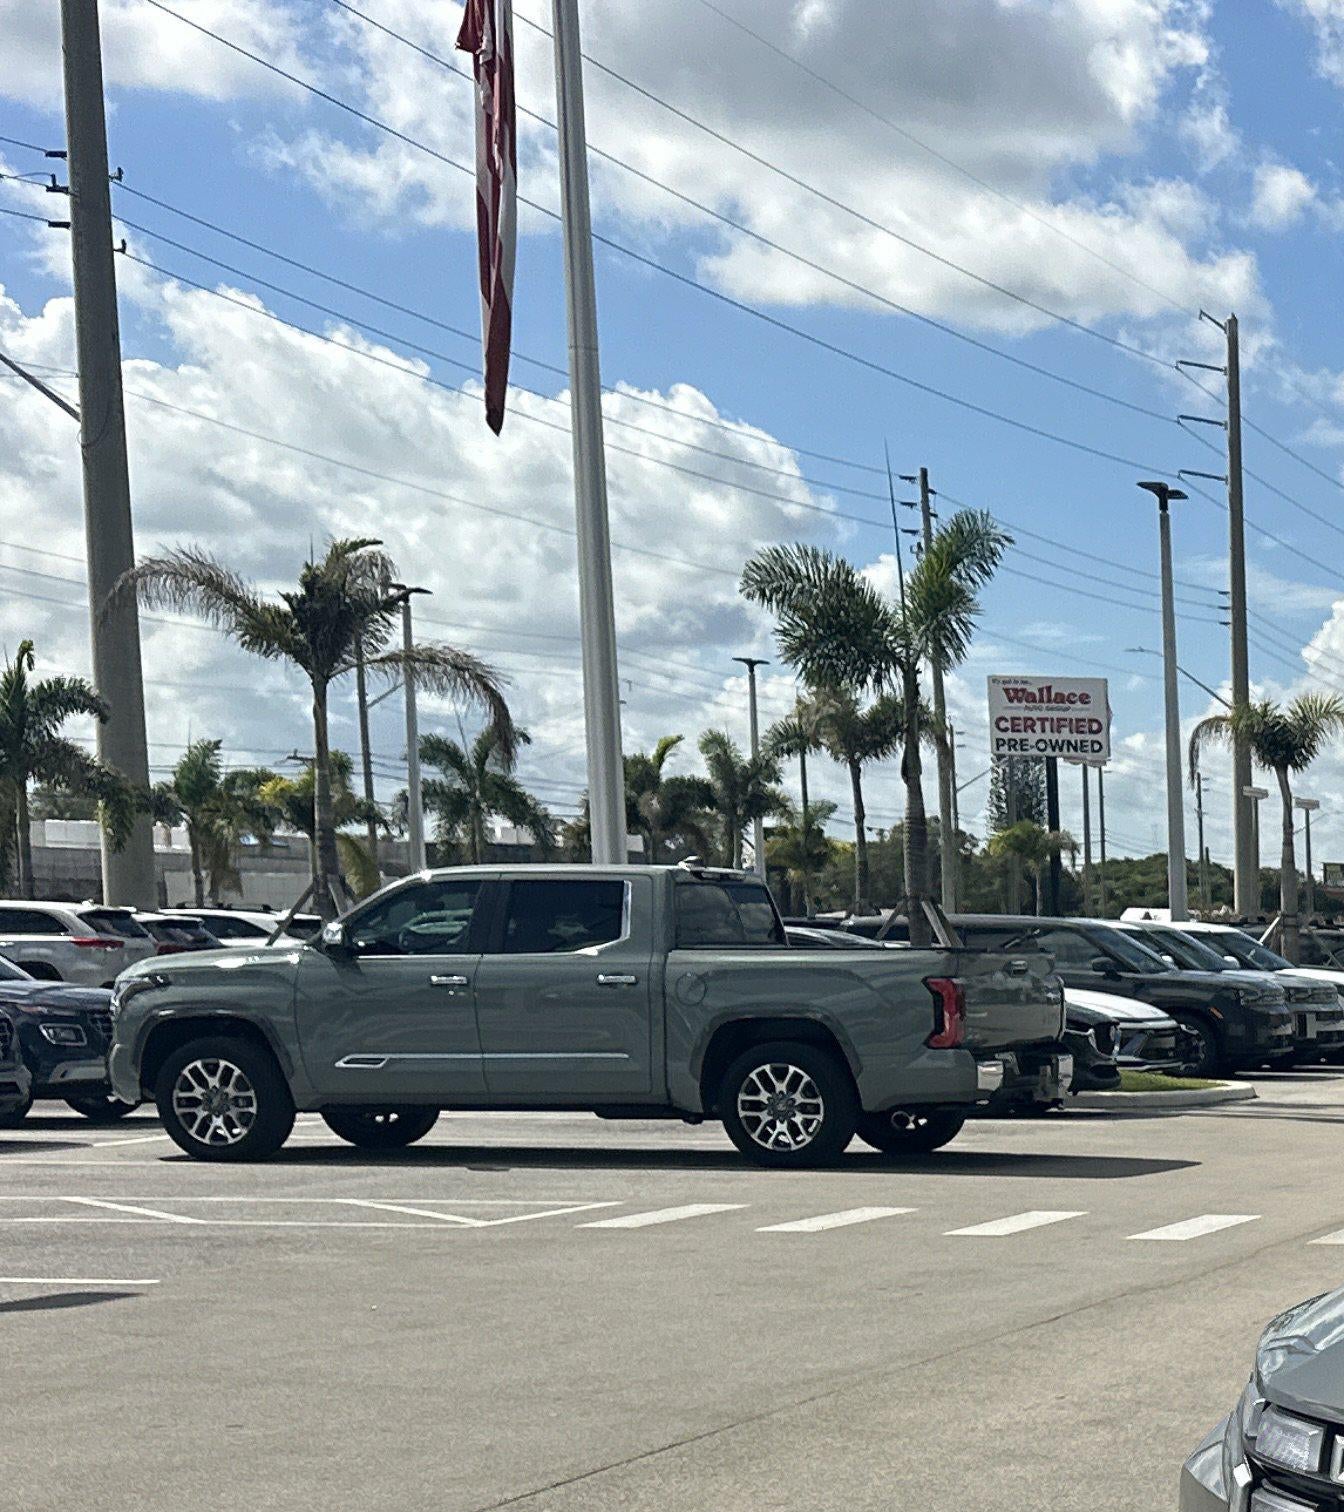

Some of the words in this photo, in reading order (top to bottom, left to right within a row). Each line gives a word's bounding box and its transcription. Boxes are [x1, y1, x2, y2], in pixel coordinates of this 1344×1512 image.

[1002, 685, 1092, 705] Wallace
[995, 716, 1103, 735] CERTIFIED
[995, 738, 1104, 754] PRE-OWNED
